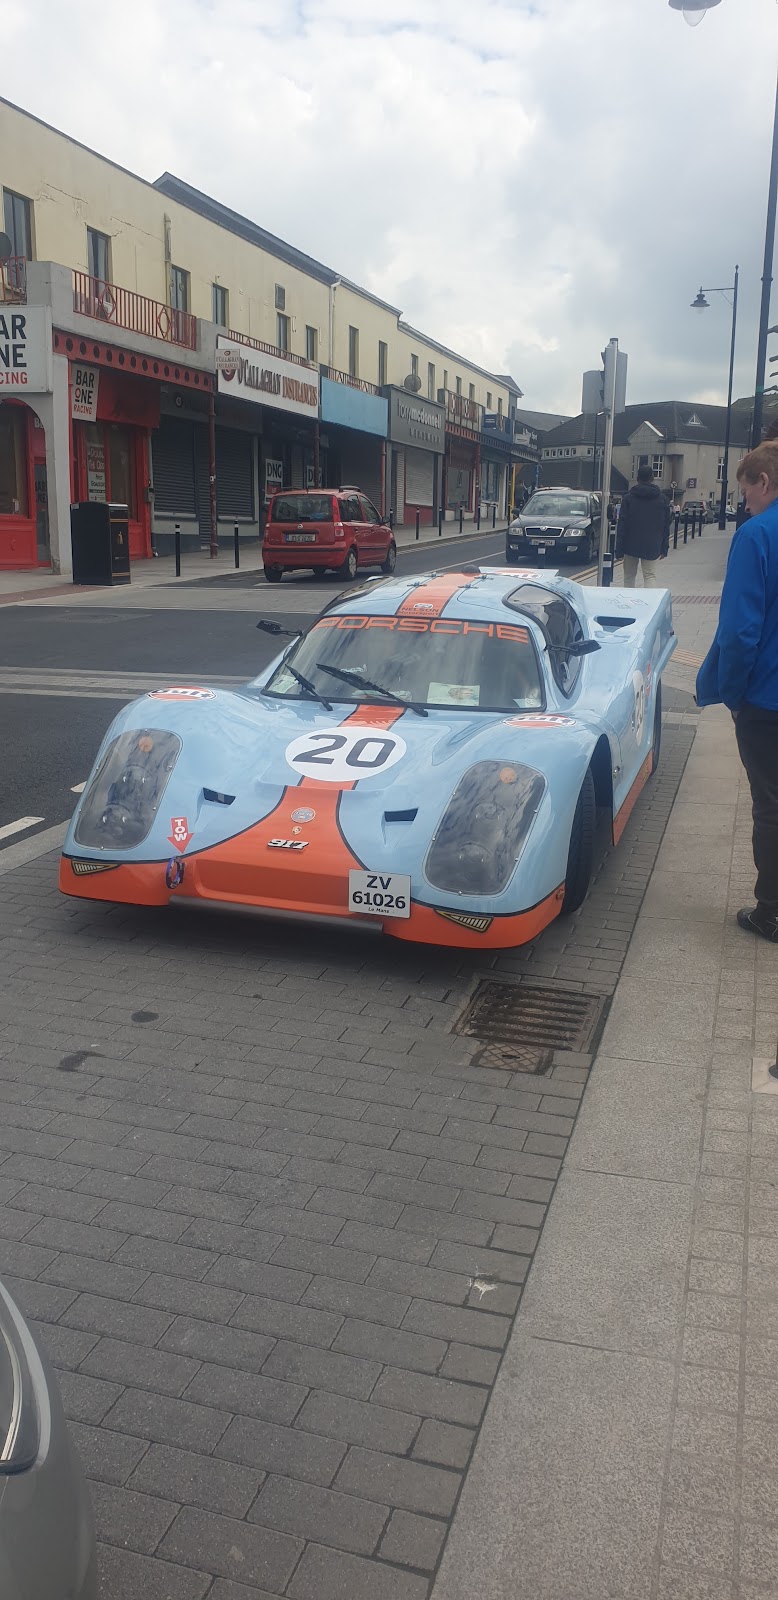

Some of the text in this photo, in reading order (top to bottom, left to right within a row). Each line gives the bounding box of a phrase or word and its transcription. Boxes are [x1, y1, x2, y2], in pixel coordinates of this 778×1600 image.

[75, 369, 95, 389] BAR
[74, 387, 94, 405] ONE
[282, 376, 317, 407] INSURANCES
[73, 404, 93, 415] RACING
[267, 462, 282, 479] DNG
[310, 616, 529, 644] PORSCHE
[292, 734, 397, 768] 20
[174, 819, 187, 842] TOW
[267, 838, 310, 851] 917
[366, 875, 392, 890] ZV
[352, 891, 406, 909] 61026
